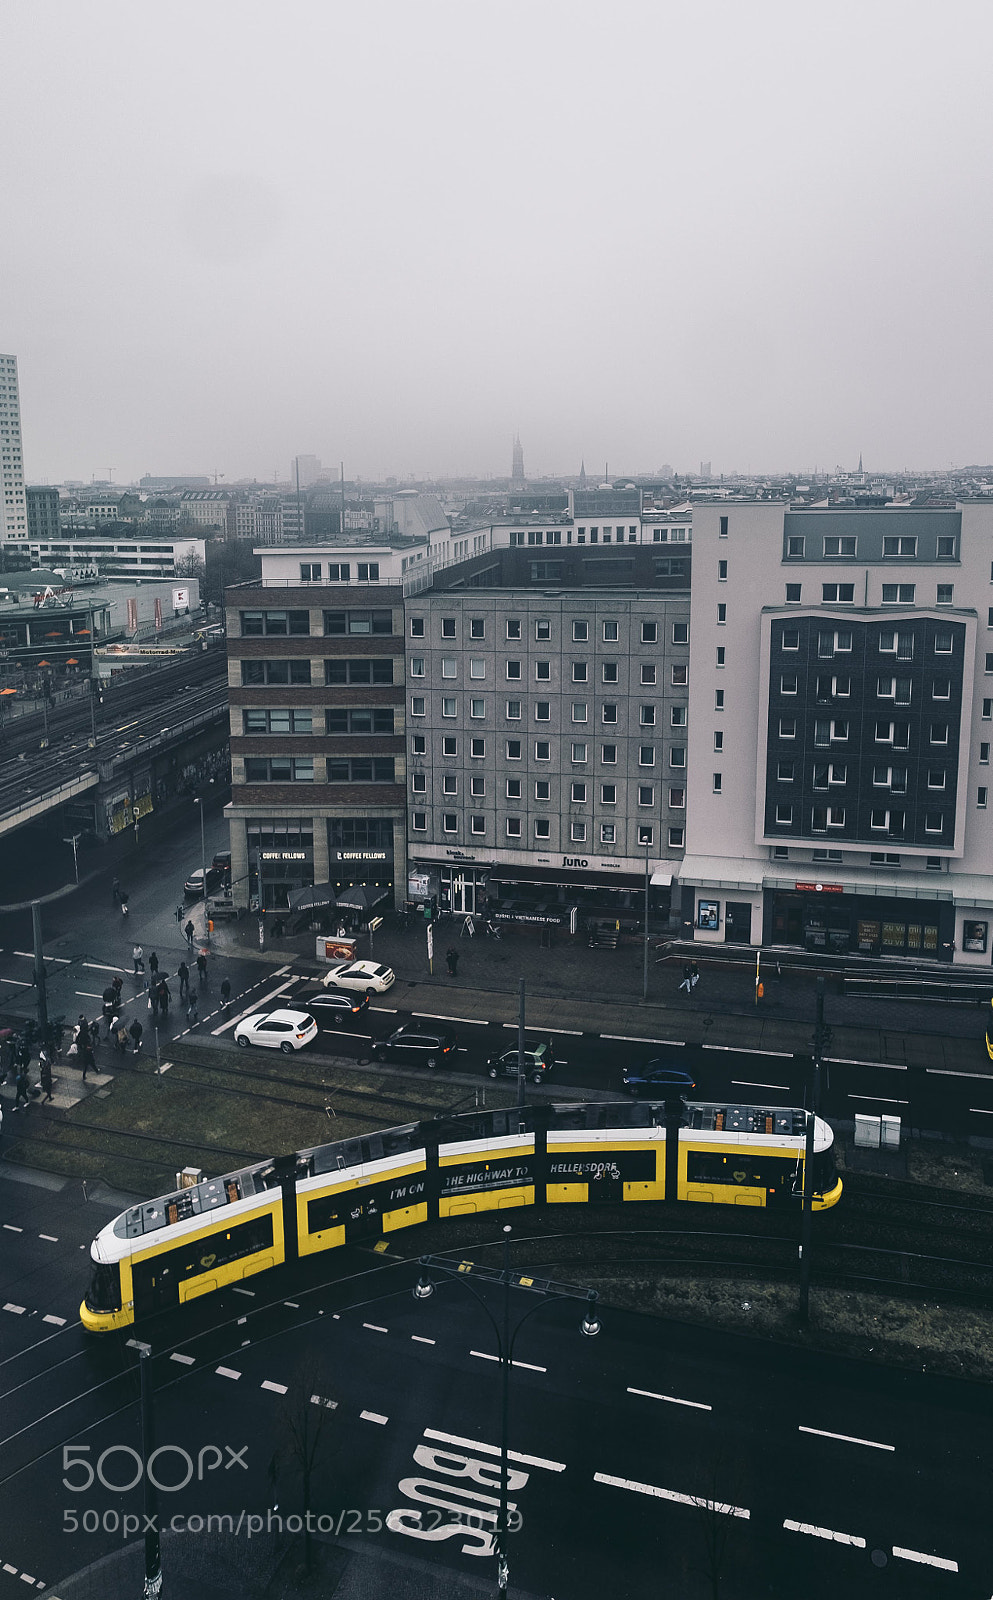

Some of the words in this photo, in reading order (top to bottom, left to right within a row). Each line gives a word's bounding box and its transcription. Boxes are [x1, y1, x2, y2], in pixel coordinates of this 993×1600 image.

[262, 852, 281, 860] COFFEE
[282, 852, 306, 860] FELLOWS
[343, 852, 362, 860] COFFEE
[363, 852, 386, 860] FELLOWS
[390, 1187, 406, 1200] I'M
[409, 1182, 425, 1194] ON
[446, 1175, 465, 1187] THE
[466, 1168, 513, 1183] HIGHWAY
[515, 1166, 529, 1177] TO
[550, 1162, 617, 1173] HELLERSDORF
[386, 1444, 530, 1557] BUS
